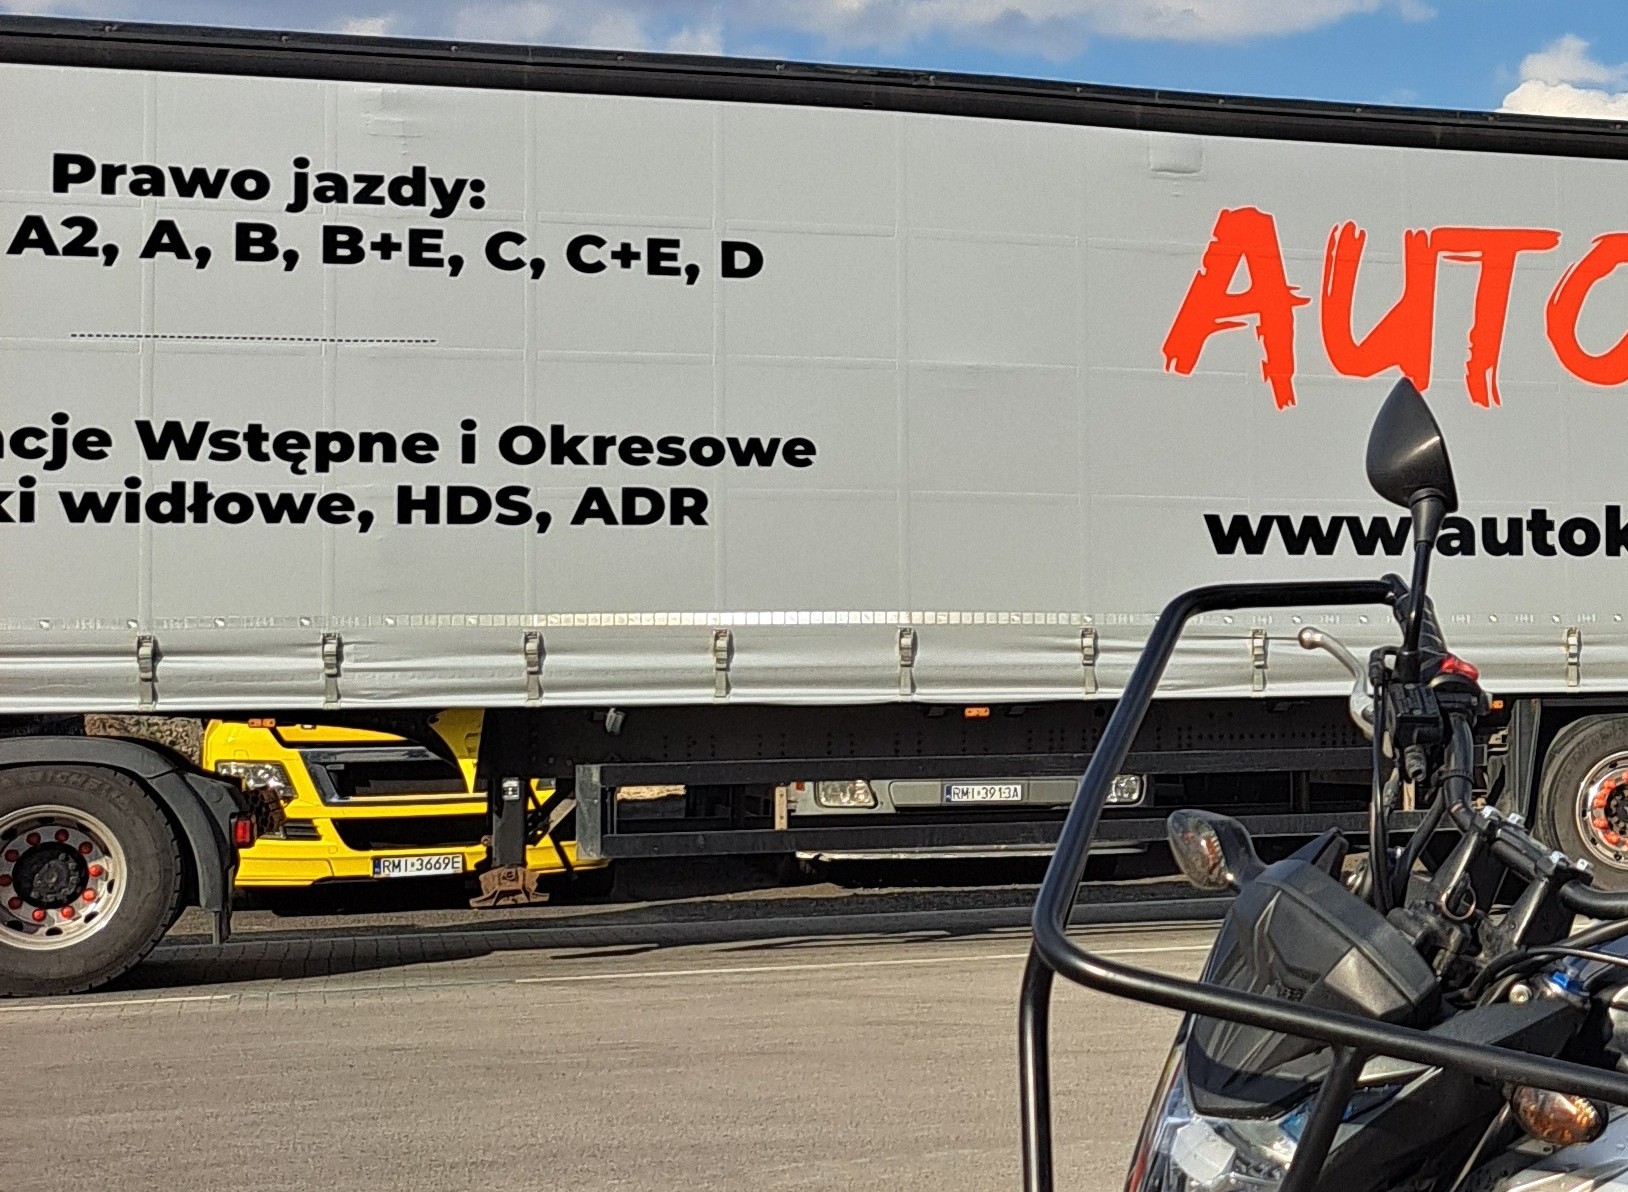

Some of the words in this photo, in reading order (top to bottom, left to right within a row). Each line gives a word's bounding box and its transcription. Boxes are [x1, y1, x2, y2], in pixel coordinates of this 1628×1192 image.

[52, 152, 271, 201] Prawo
[285, 156, 486, 216] jazdy:
[6, 214, 119, 267] A2,
[138, 219, 212, 270] A,
[235, 222, 300, 272] B,
[322, 224, 464, 278] B+E,
[484, 230, 546, 280] C,
[566, 234, 700, 286] C+E,
[721, 240, 764, 279] D
[0, 411, 113, 472] cje
[134, 419, 440, 476] Wstępne
[460, 418, 477, 465] i
[498, 424, 817, 468] Okresowe
[58, 476, 374, 534] widłowe,
[397, 485, 552, 534] HDS,
[570, 486, 709, 526] ADR
[381, 858, 408, 874] RMI
[416, 855, 461, 872] 3669E
